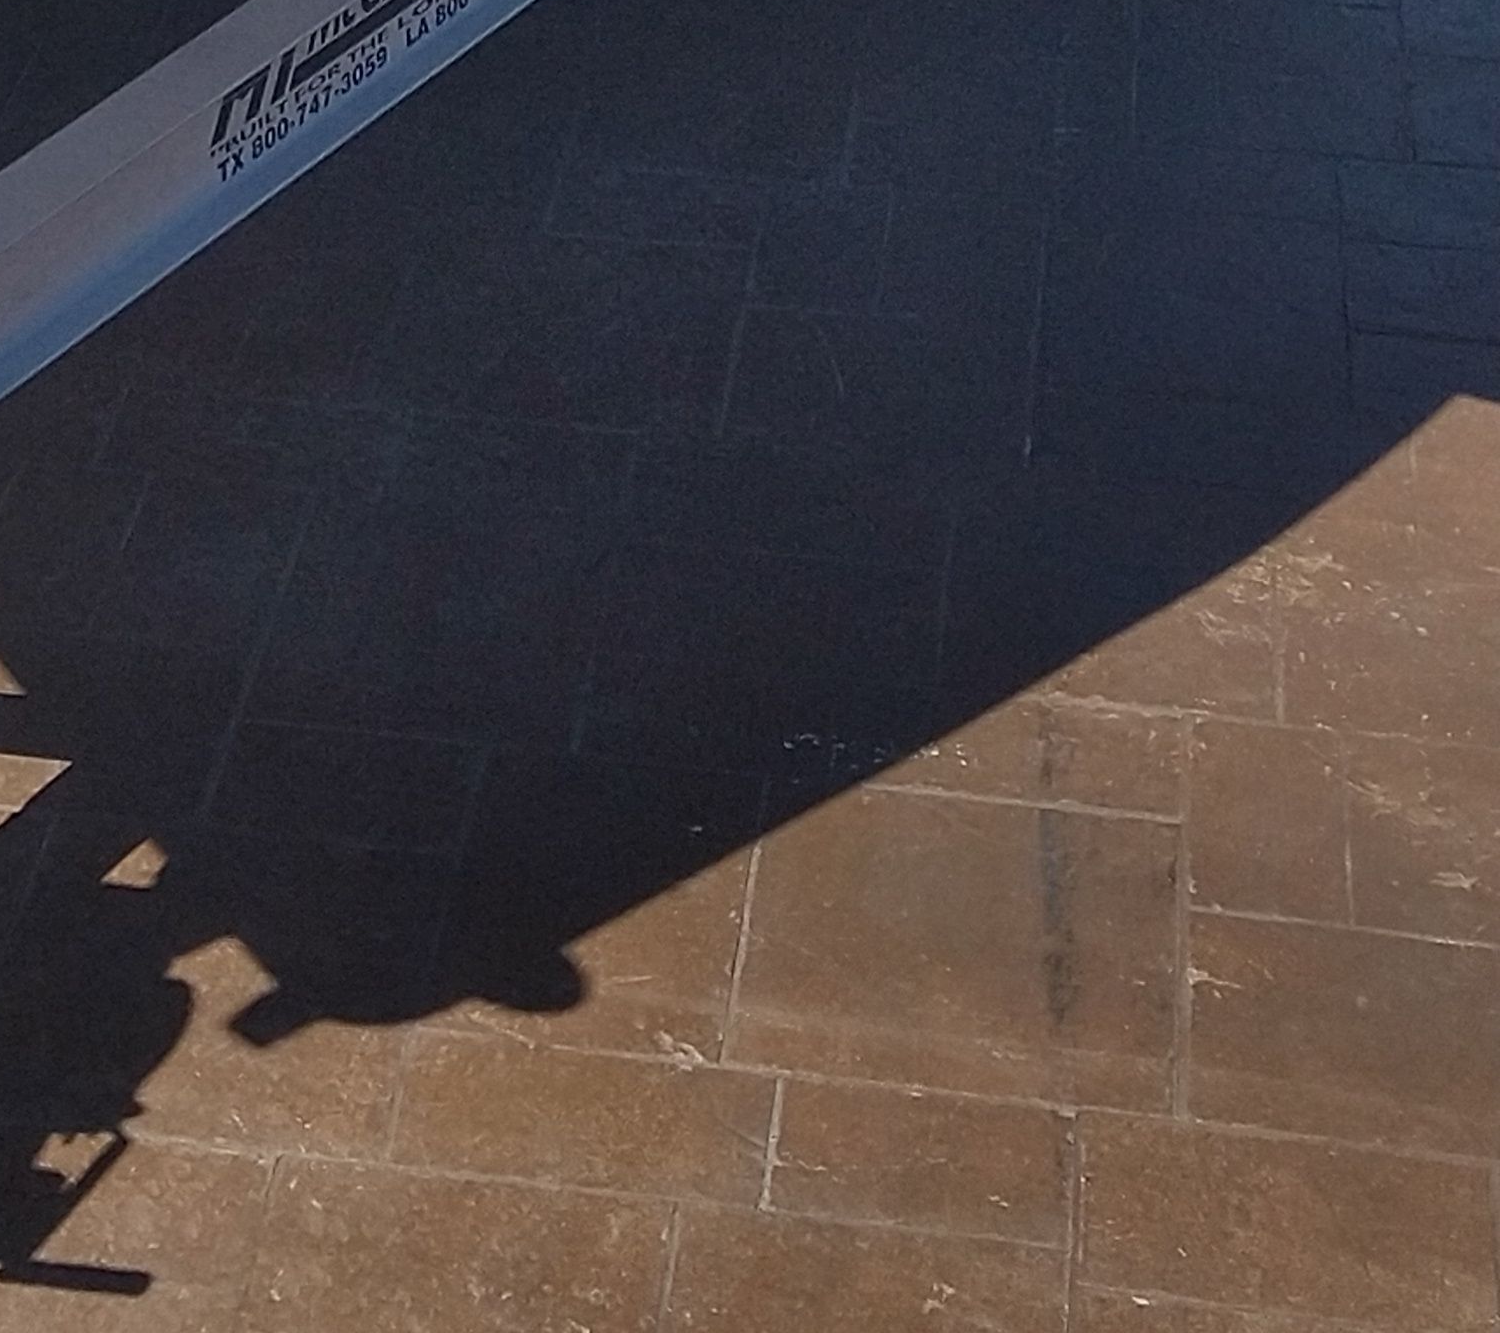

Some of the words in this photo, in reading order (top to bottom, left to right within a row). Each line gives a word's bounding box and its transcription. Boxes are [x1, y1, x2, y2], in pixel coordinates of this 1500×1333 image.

[216, 146, 244, 182] TX
[251, 46, 388, 160] 800-747-3059
[405, 16, 430, 47] LA
[294, 63, 342, 104] FOR
[347, 26, 389, 63] THE
